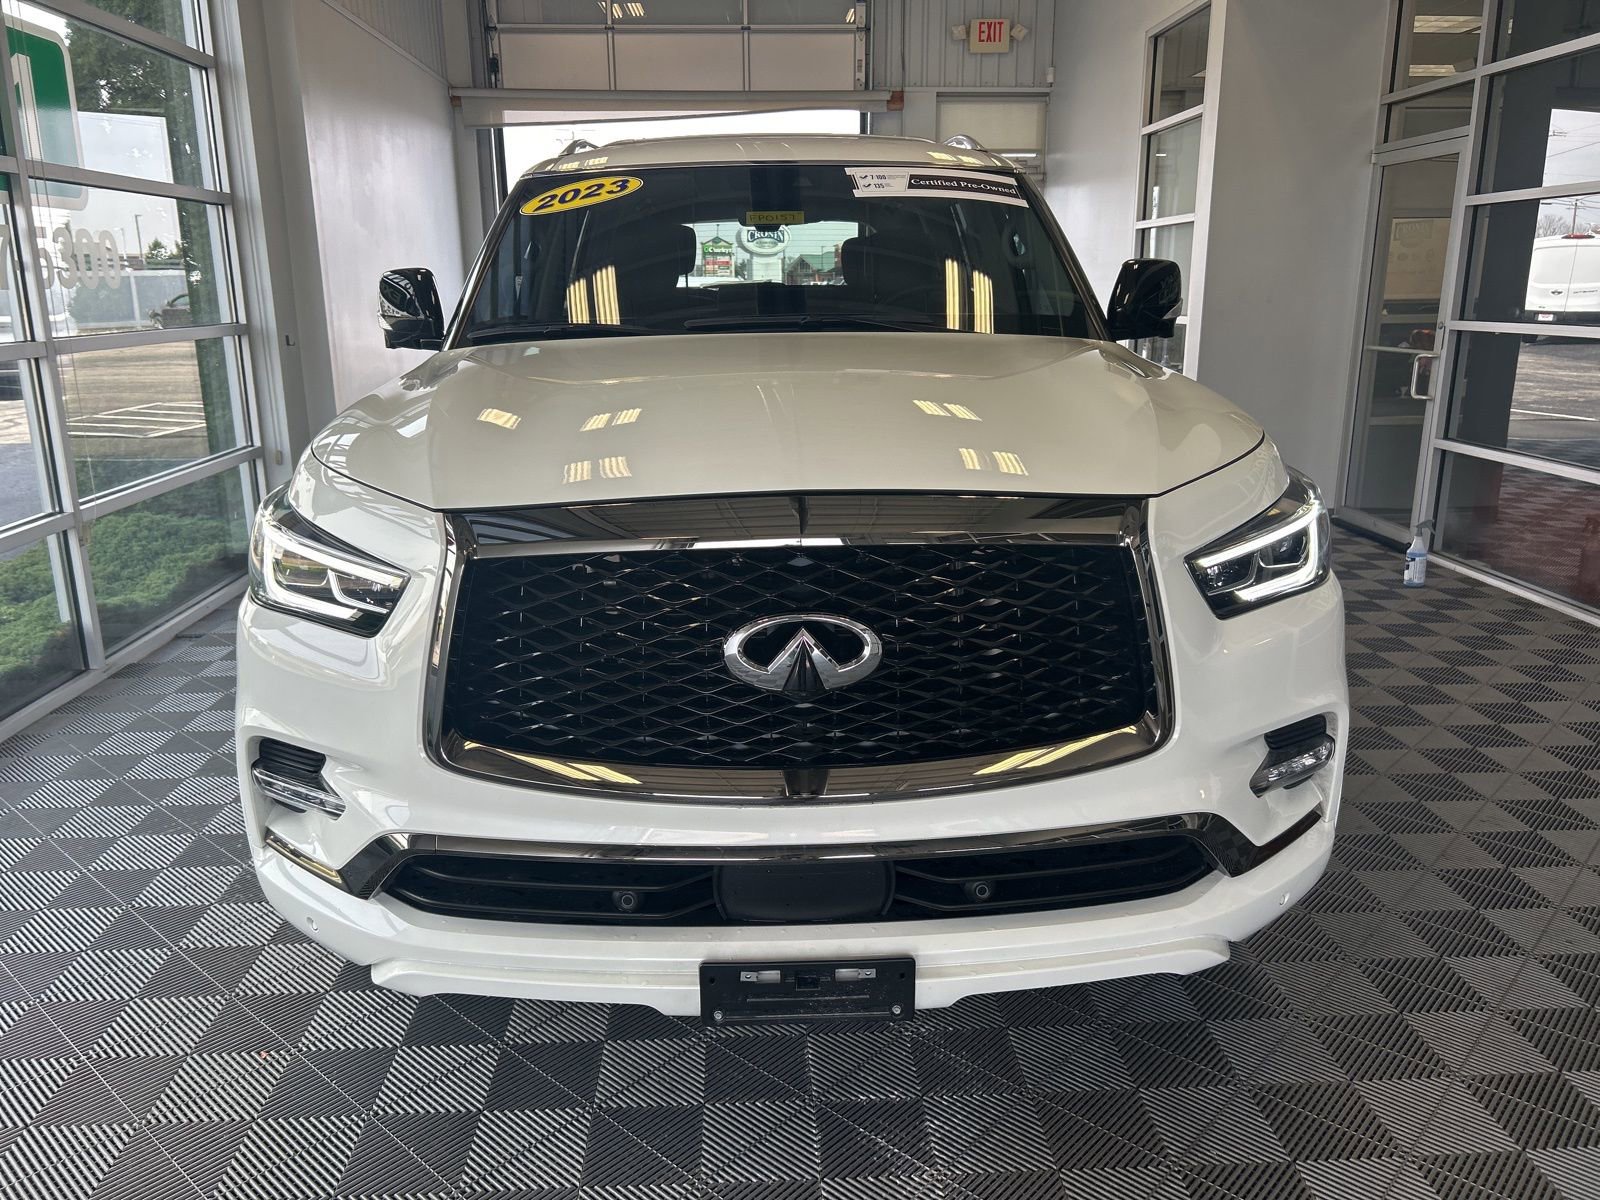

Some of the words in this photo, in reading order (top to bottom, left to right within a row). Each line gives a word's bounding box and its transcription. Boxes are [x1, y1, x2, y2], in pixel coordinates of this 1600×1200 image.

[978, 21, 1004, 43] EXIT
[532, 179, 630, 212] 2023
[910, 178, 958, 188] Certified
[959, 180, 1017, 195] Pre-Owned
[747, 230, 784, 242] CRONIN
